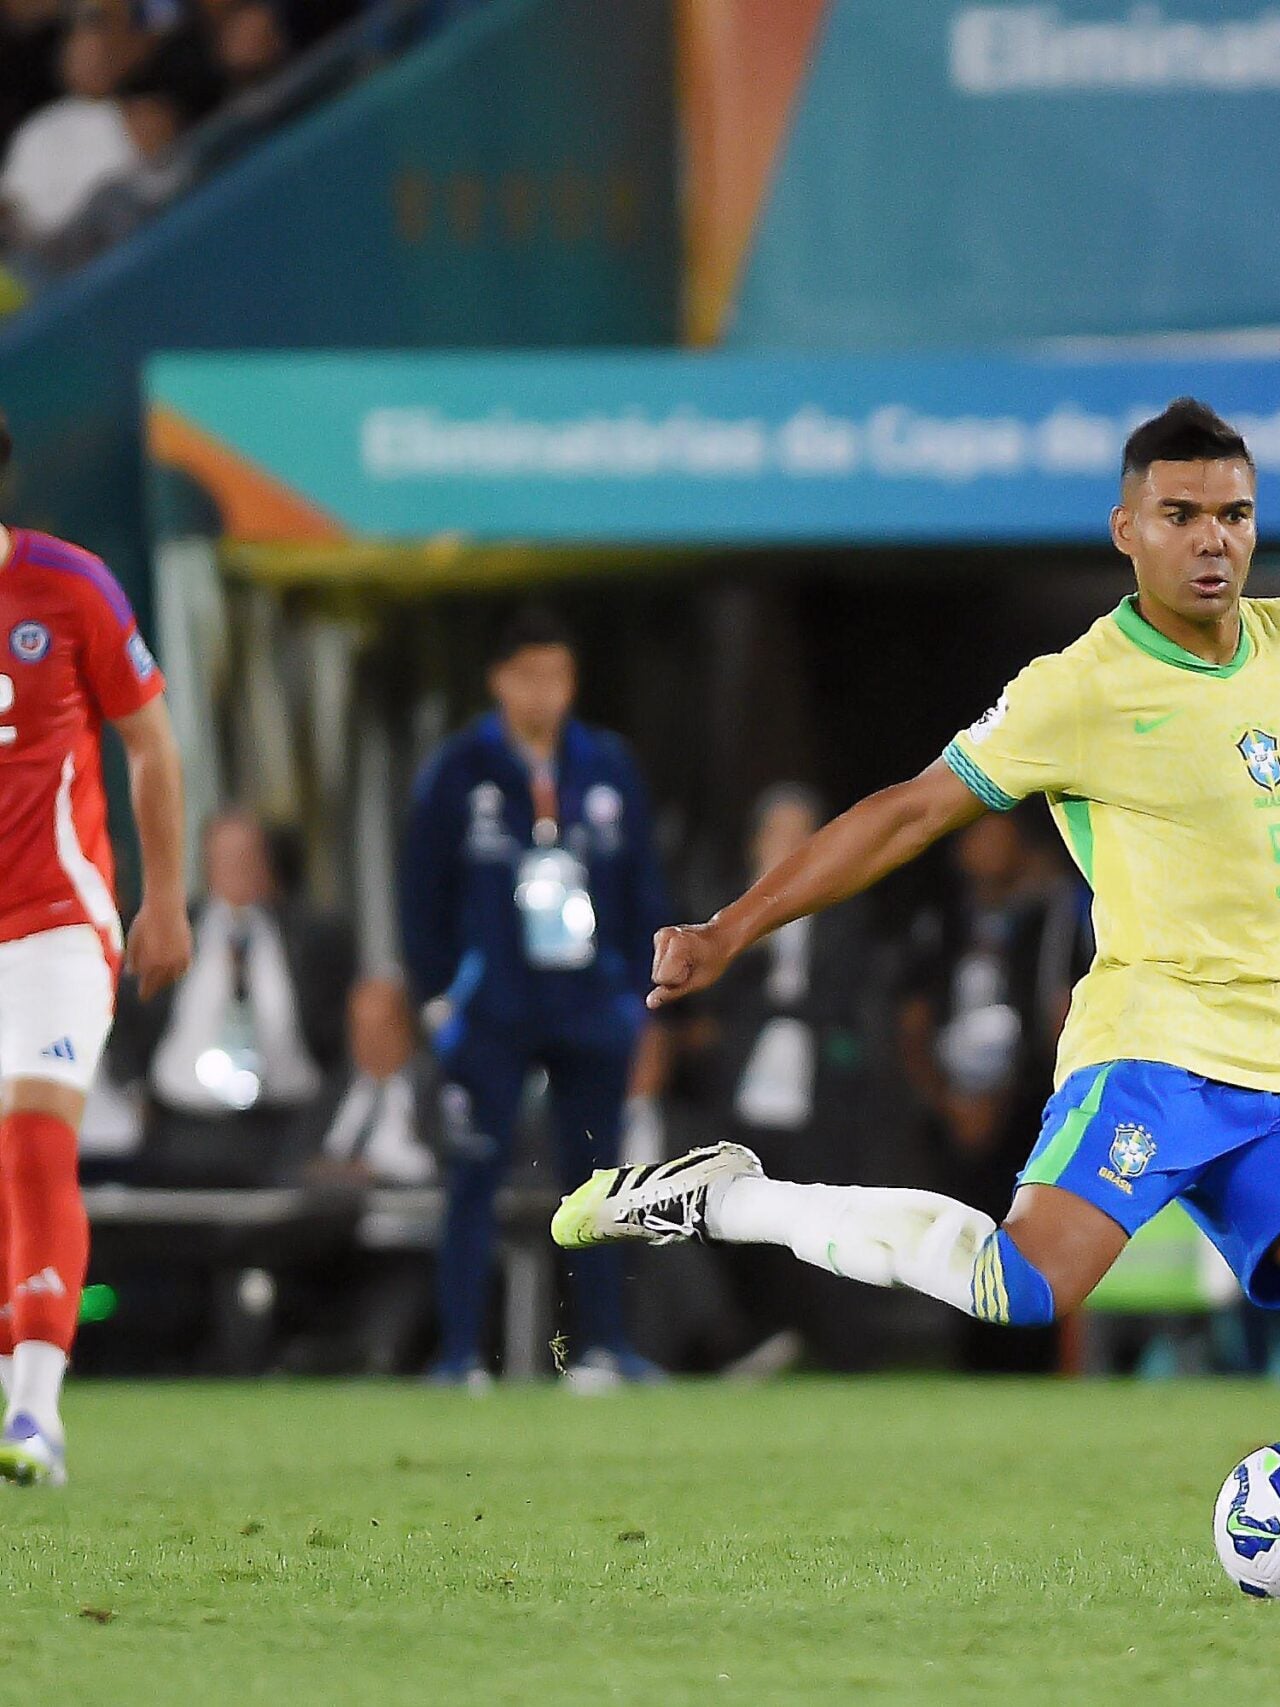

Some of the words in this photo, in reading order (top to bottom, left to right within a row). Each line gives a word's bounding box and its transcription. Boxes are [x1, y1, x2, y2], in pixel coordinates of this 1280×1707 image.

[781, 403, 860, 475] da
[868, 404, 1023, 483] Copa
[1098, 1167, 1133, 1195] BRASIL
